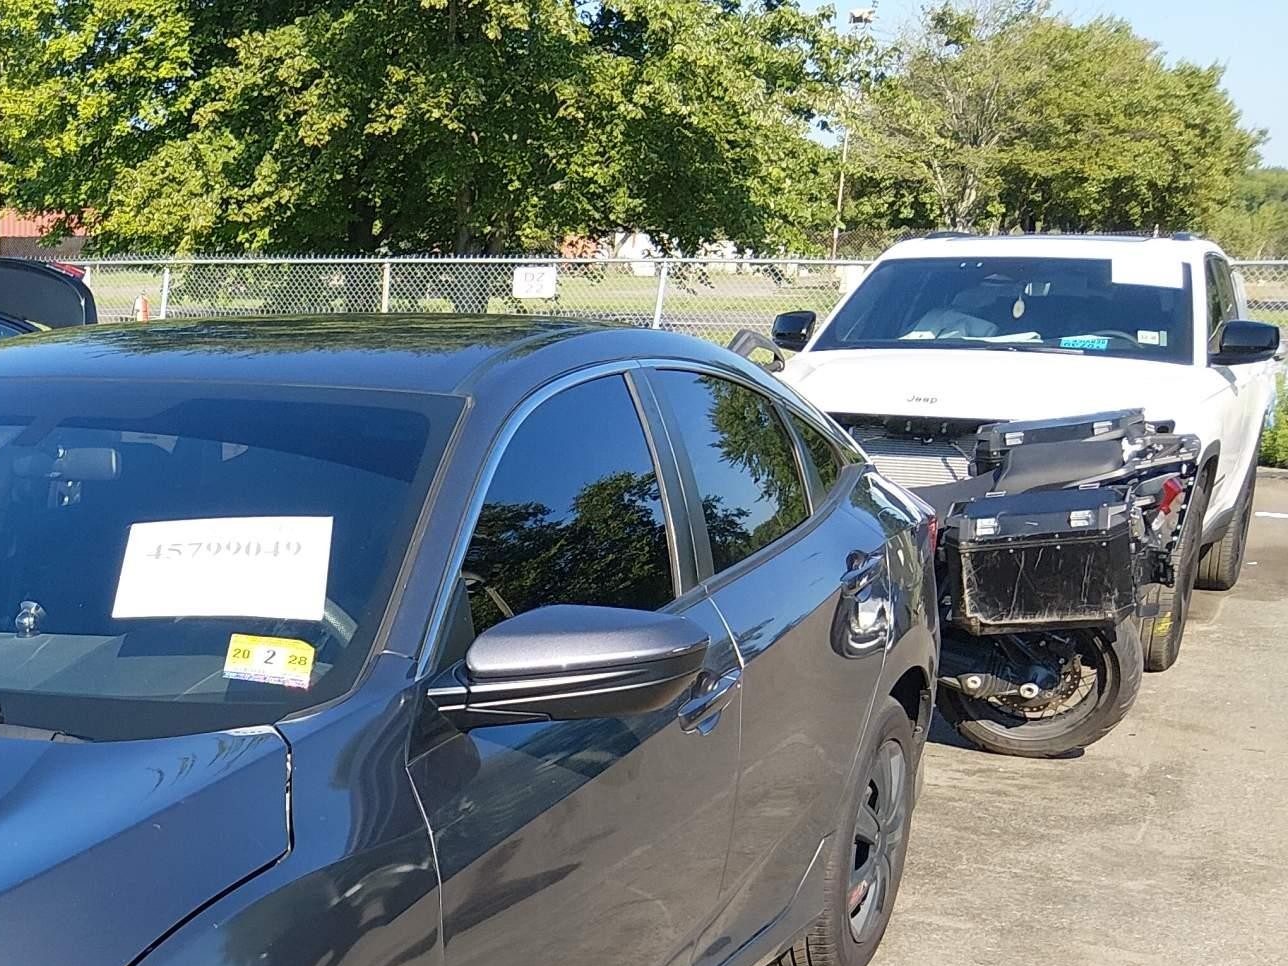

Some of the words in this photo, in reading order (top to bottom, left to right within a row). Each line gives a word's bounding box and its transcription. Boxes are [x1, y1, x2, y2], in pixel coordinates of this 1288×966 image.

[906, 394, 939, 405] Jeep
[146, 540, 302, 560] 45799049
[232, 648, 251, 660] 20
[263, 649, 277, 665] 2
[288, 654, 308, 667] 28
